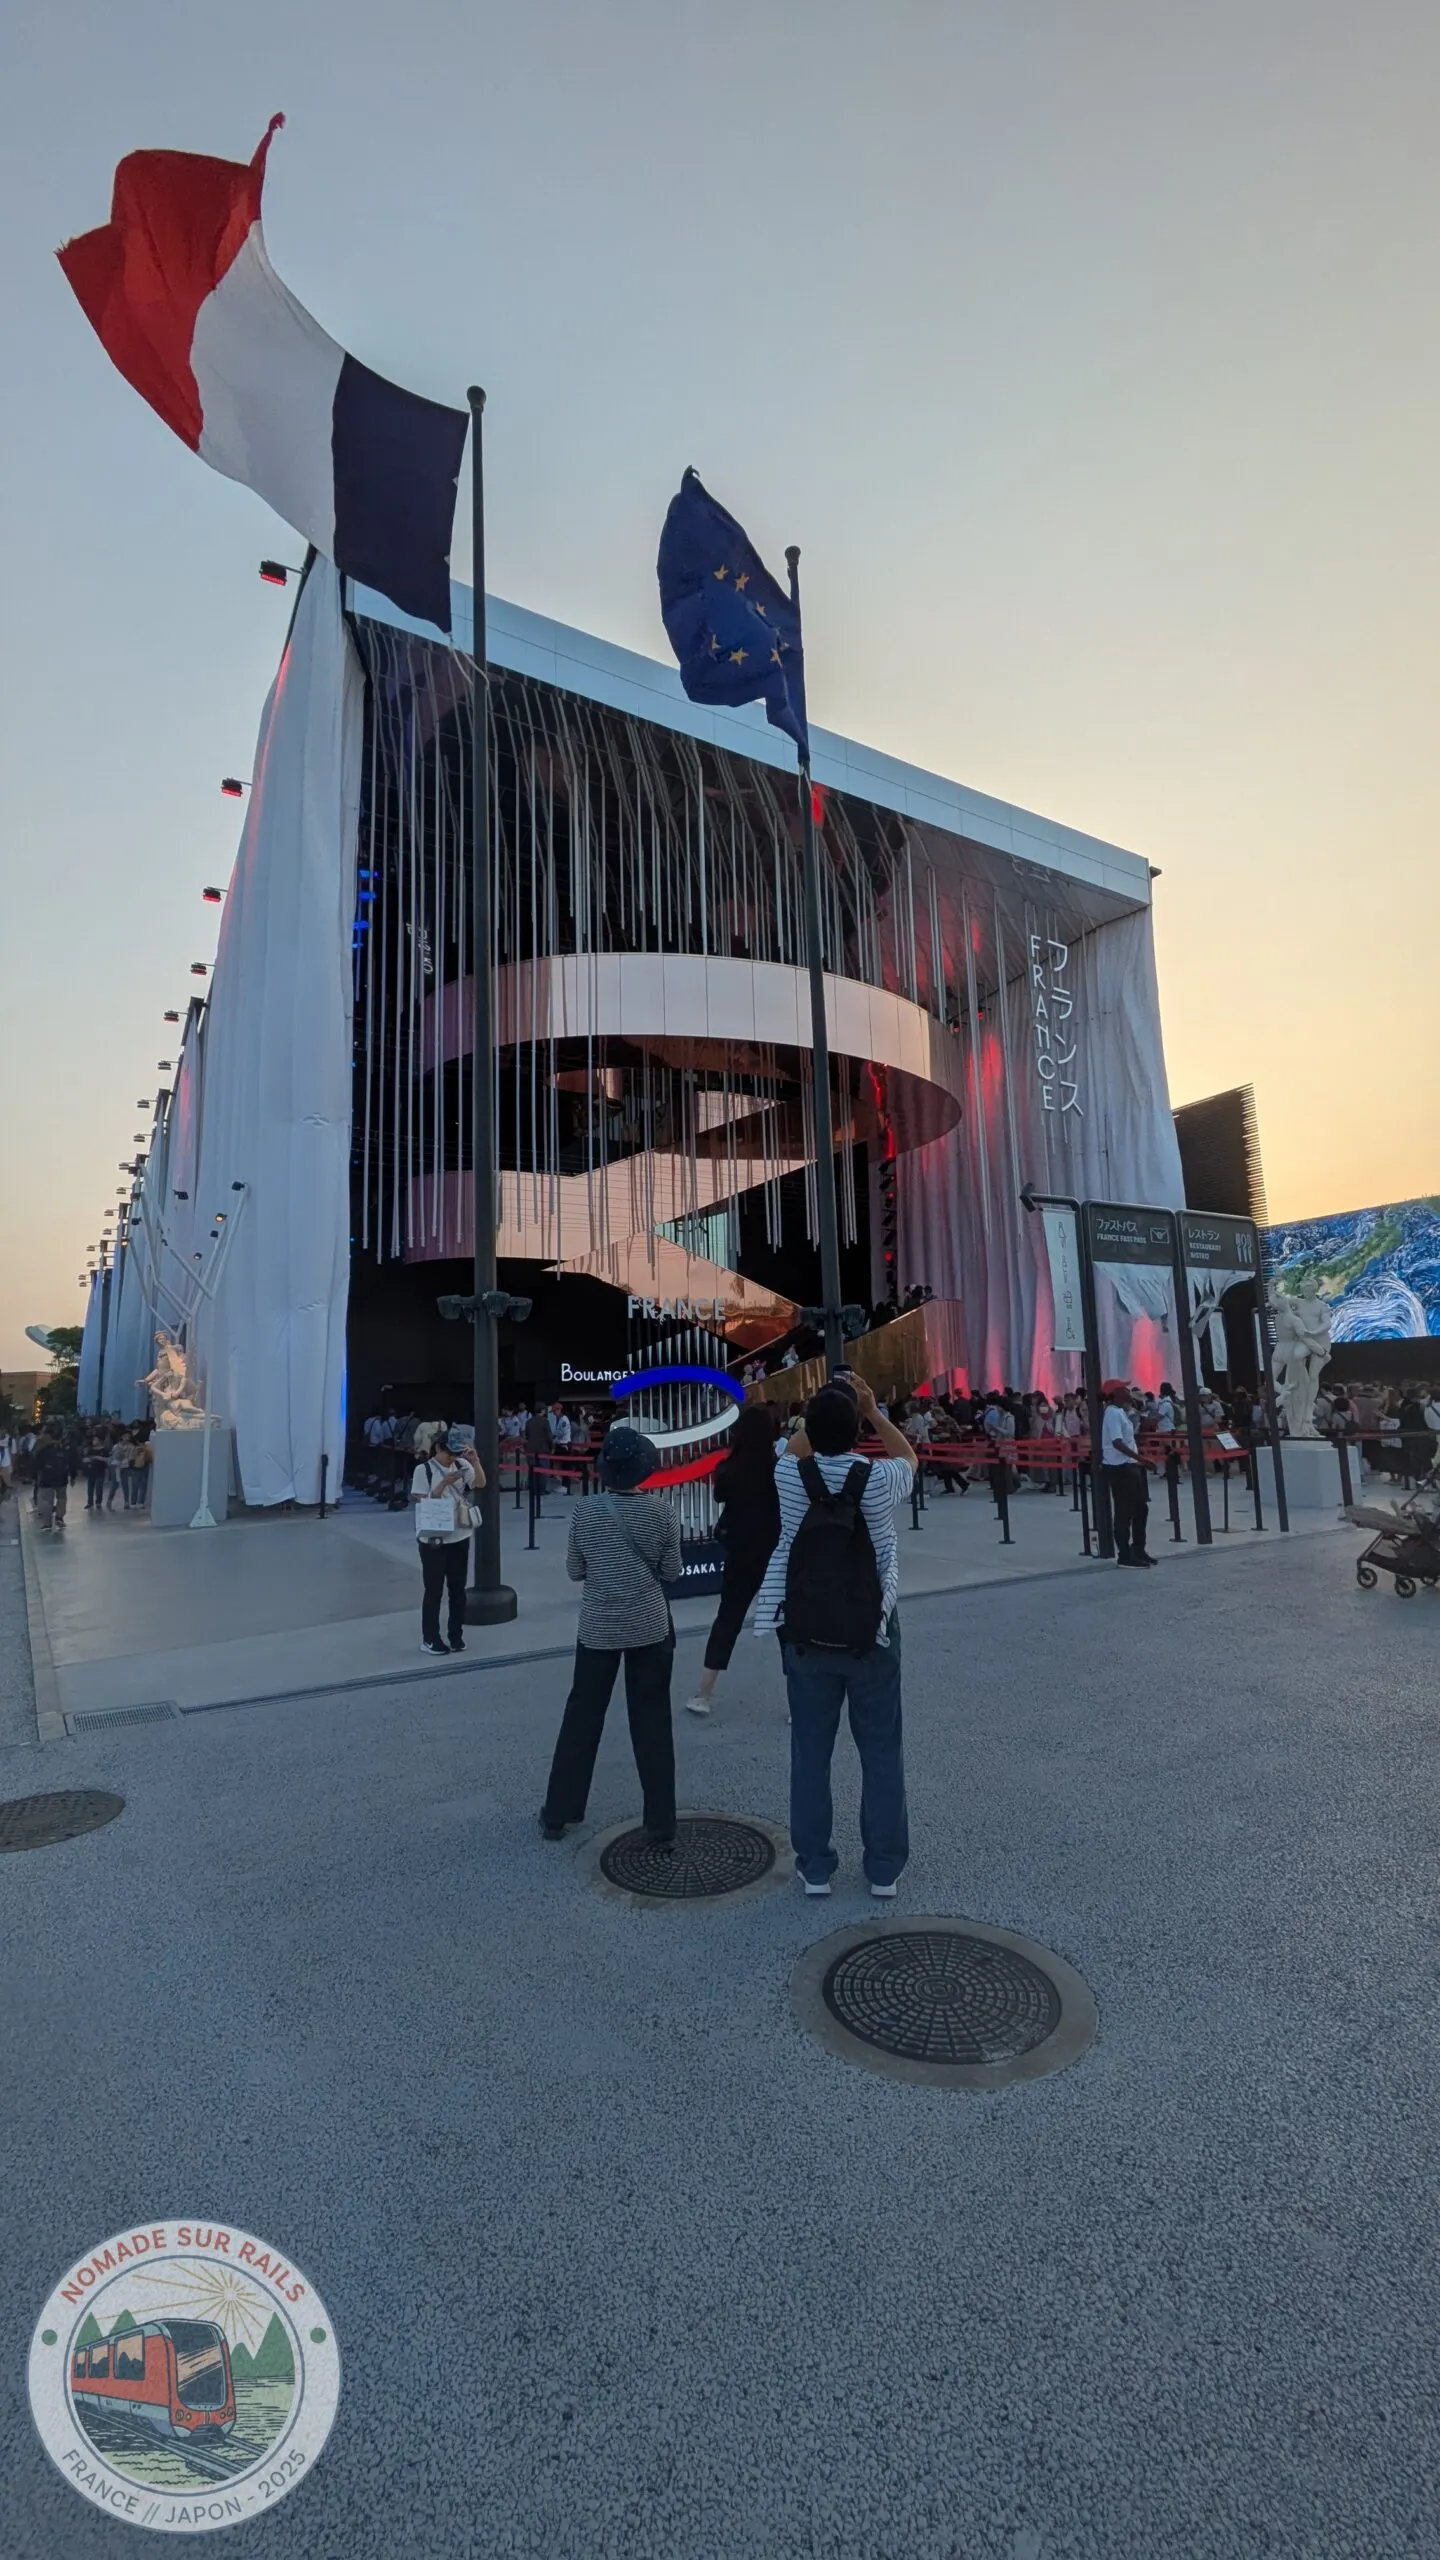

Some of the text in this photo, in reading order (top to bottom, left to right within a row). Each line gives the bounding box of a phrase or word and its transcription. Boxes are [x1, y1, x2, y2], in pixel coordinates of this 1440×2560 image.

[1030, 934, 1056, 1111] FRANCE
[1047, 938, 1084, 1116] フランス
[1096, 1218, 1138, 1233] ファストパス
[1188, 1228, 1220, 1241] レストラン
[1096, 1233, 1119, 1242] FRANCE
[627, 1295, 726, 1320] FRANCE
[561, 1363, 635, 1381] BOULANGE
